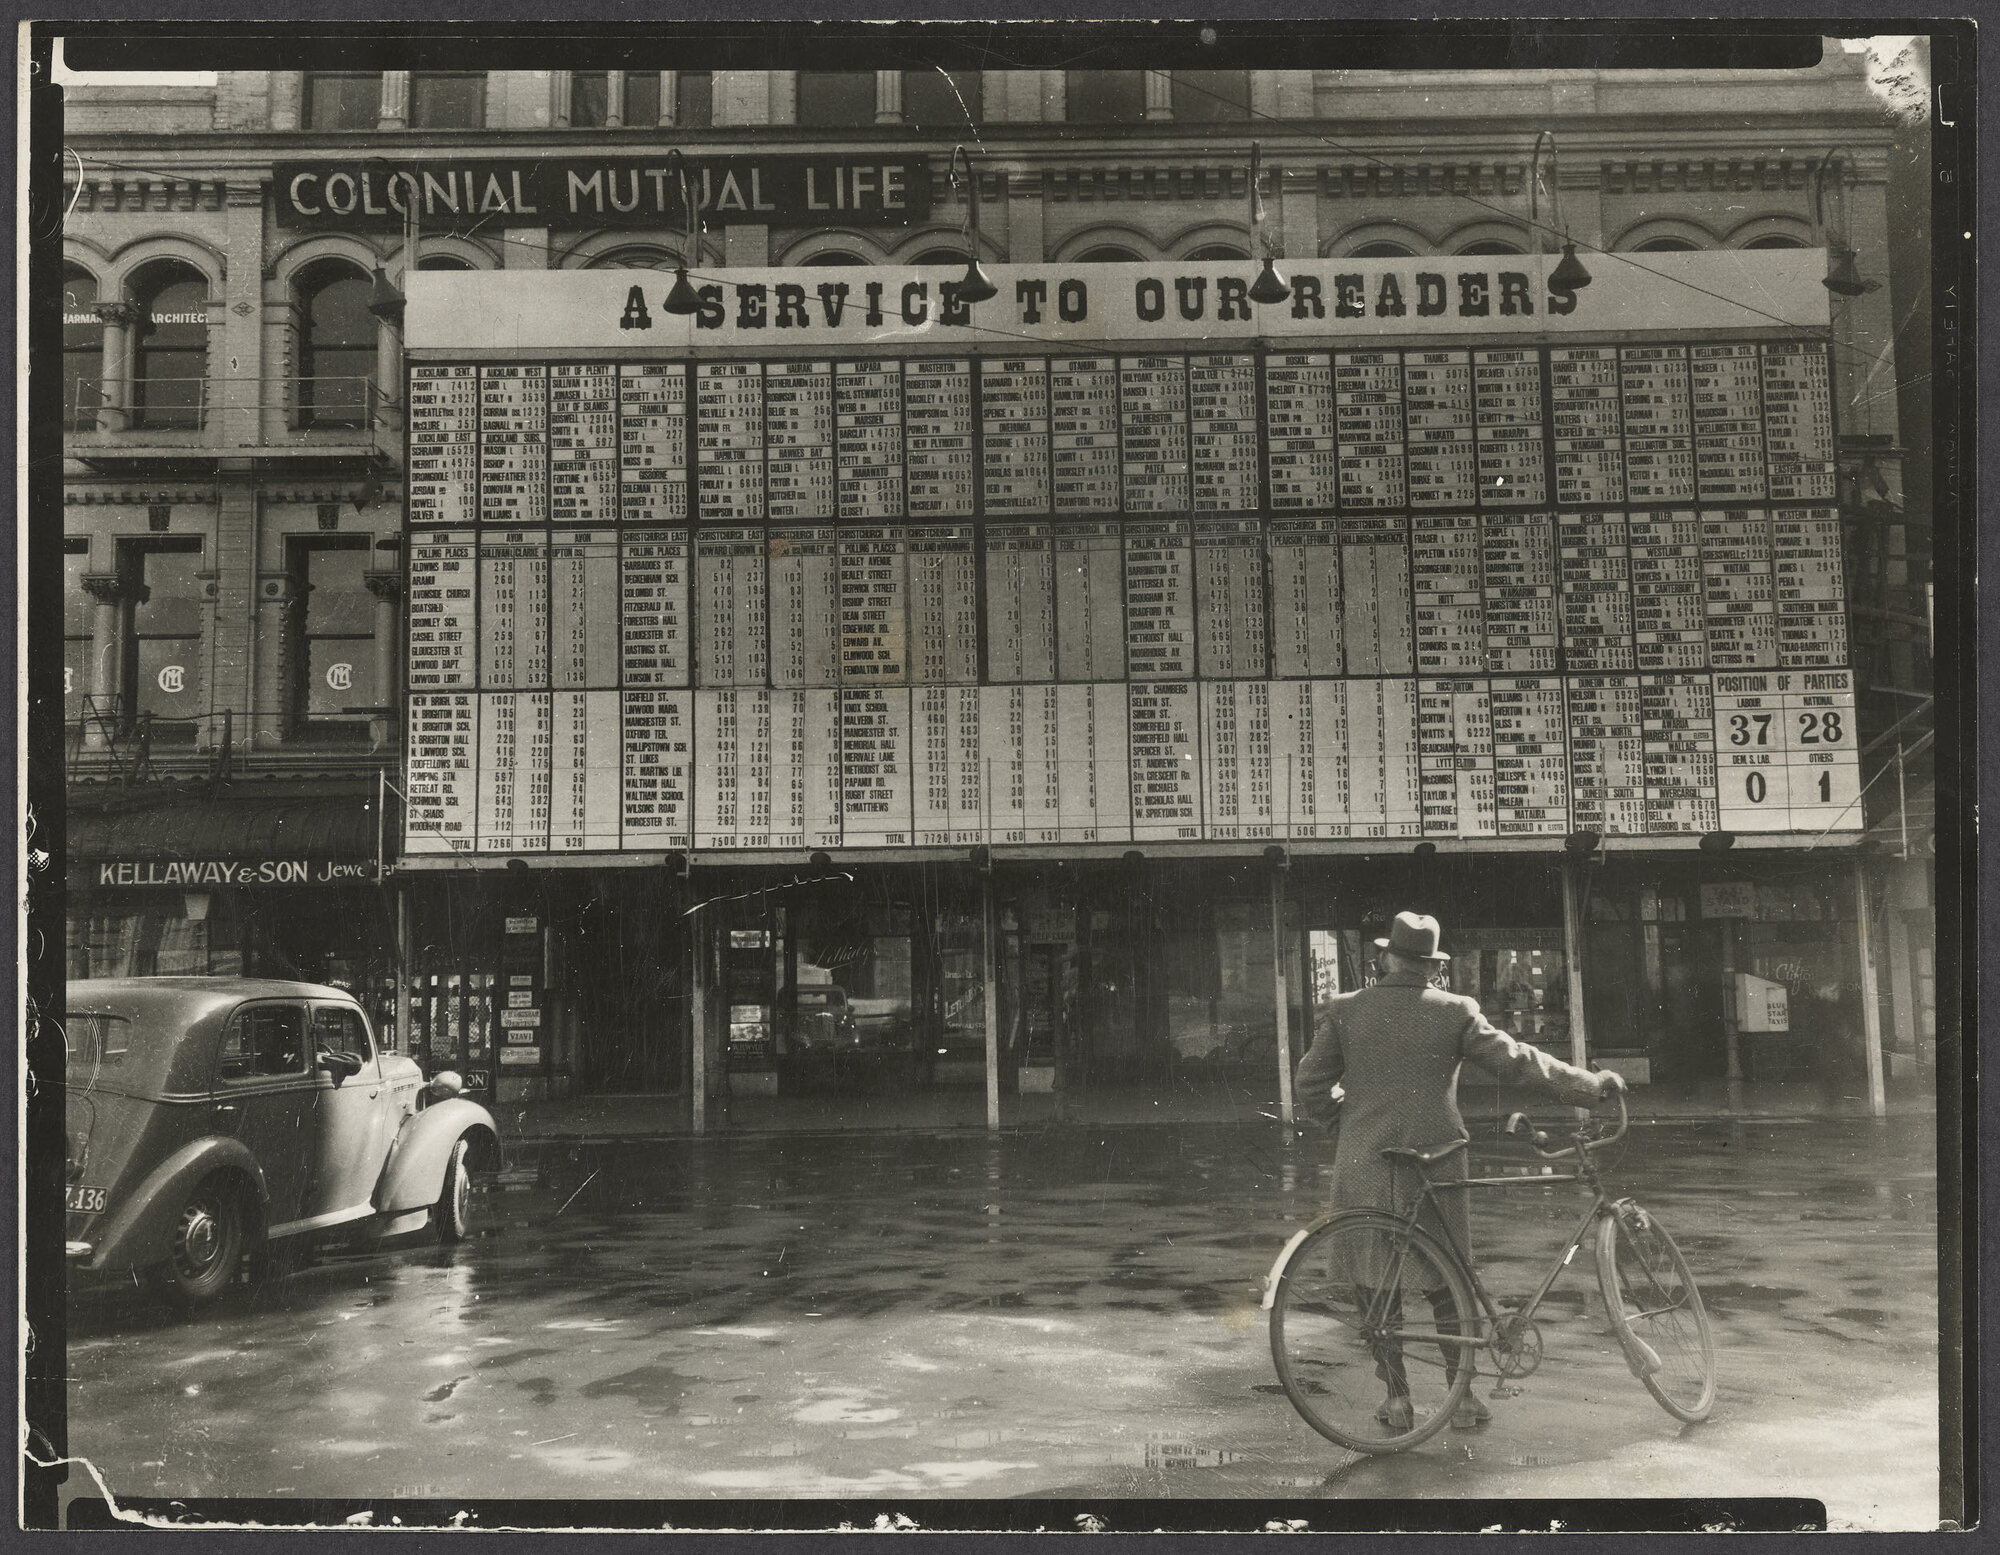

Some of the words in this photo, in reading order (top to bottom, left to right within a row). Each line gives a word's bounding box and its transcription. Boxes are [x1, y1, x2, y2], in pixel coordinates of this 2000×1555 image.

[291, 170, 536, 215] COLONIAL
[569, 168, 775, 212] MUTUAL
[807, 166, 905, 210] LIFE
[620, 285, 652, 329] A
[696, 283, 970, 327] SERVICE
[1017, 279, 1087, 323] TO
[1136, 277, 1252, 322] OUR
[525, 368, 541, 376] WEST
[558, 367, 572, 376] BAY
[575, 366, 582, 375] OF
[586, 366, 608, 375] PLENTY
[452, 382, 475, 390] 7412
[622, 379, 634, 388] COX
[661, 378, 684, 388] 2444
[1409, 415, 1422, 425] DAY
[455, 433, 470, 441] EAST
[624, 431, 638, 440] BEST
[913, 439, 927, 448] NEW
[810, 449, 823, 457] BAY
[1145, 464, 1165, 474] PATEA
[459, 496, 474, 505] 100
[433, 535, 449, 543] AVON
[671, 532, 687, 541] EAST
[446, 548, 468, 557] PLACES
[1439, 594, 1454, 604] HUTT
[662, 616, 677, 625] HALL
[863, 611, 885, 620] STREET
[1417, 610, 1435, 621] NASH
[439, 632, 461, 641] STREET
[1718, 676, 1766, 692] POSITION
[1778, 675, 1790, 690] OF
[1804, 673, 1848, 688] PARTIES
[1737, 698, 1762, 708] LABOUR
[1803, 696, 1834, 706] NATIONAL
[1730, 714, 1772, 746] 37
[1799, 712, 1842, 744] 28
[1422, 729, 1445, 739] WATTS
[1133, 746, 1161, 756] SPENCER
[1165, 746, 1175, 755] ST.
[625, 755, 636, 764] ST.
[640, 755, 659, 764] LUKES
[1809, 753, 1834, 762] OTHERS
[454, 759, 469, 768] HALL
[1147, 758, 1178, 768] ANDREWS
[410, 784, 439, 794] RETREAT
[1746, 772, 1766, 803] 0
[1818, 771, 1830, 802] 1
[661, 791, 684, 800] SCHOOL
[845, 790, 867, 799] RUGBY
[870, 790, 893, 799] STREET
[658, 803, 676, 813] ROAD
[1515, 810, 1545, 820] MATAURA
[1178, 828, 1197, 838] TOTAL
[1212, 828, 1237, 838] 7448
[1297, 827, 1314, 836] 506
[452, 839, 470, 850] TOTAL
[488, 839, 511, 849] 7266
[565, 837, 582, 847] 928
[711, 837, 735, 847] 7500
[886, 834, 905, 844] TOTAL
[924, 834, 948, 844] 7726
[956, 833, 979, 842] 5415
[100, 862, 238, 885] KELLAWAY
[259, 860, 307, 883] SON
